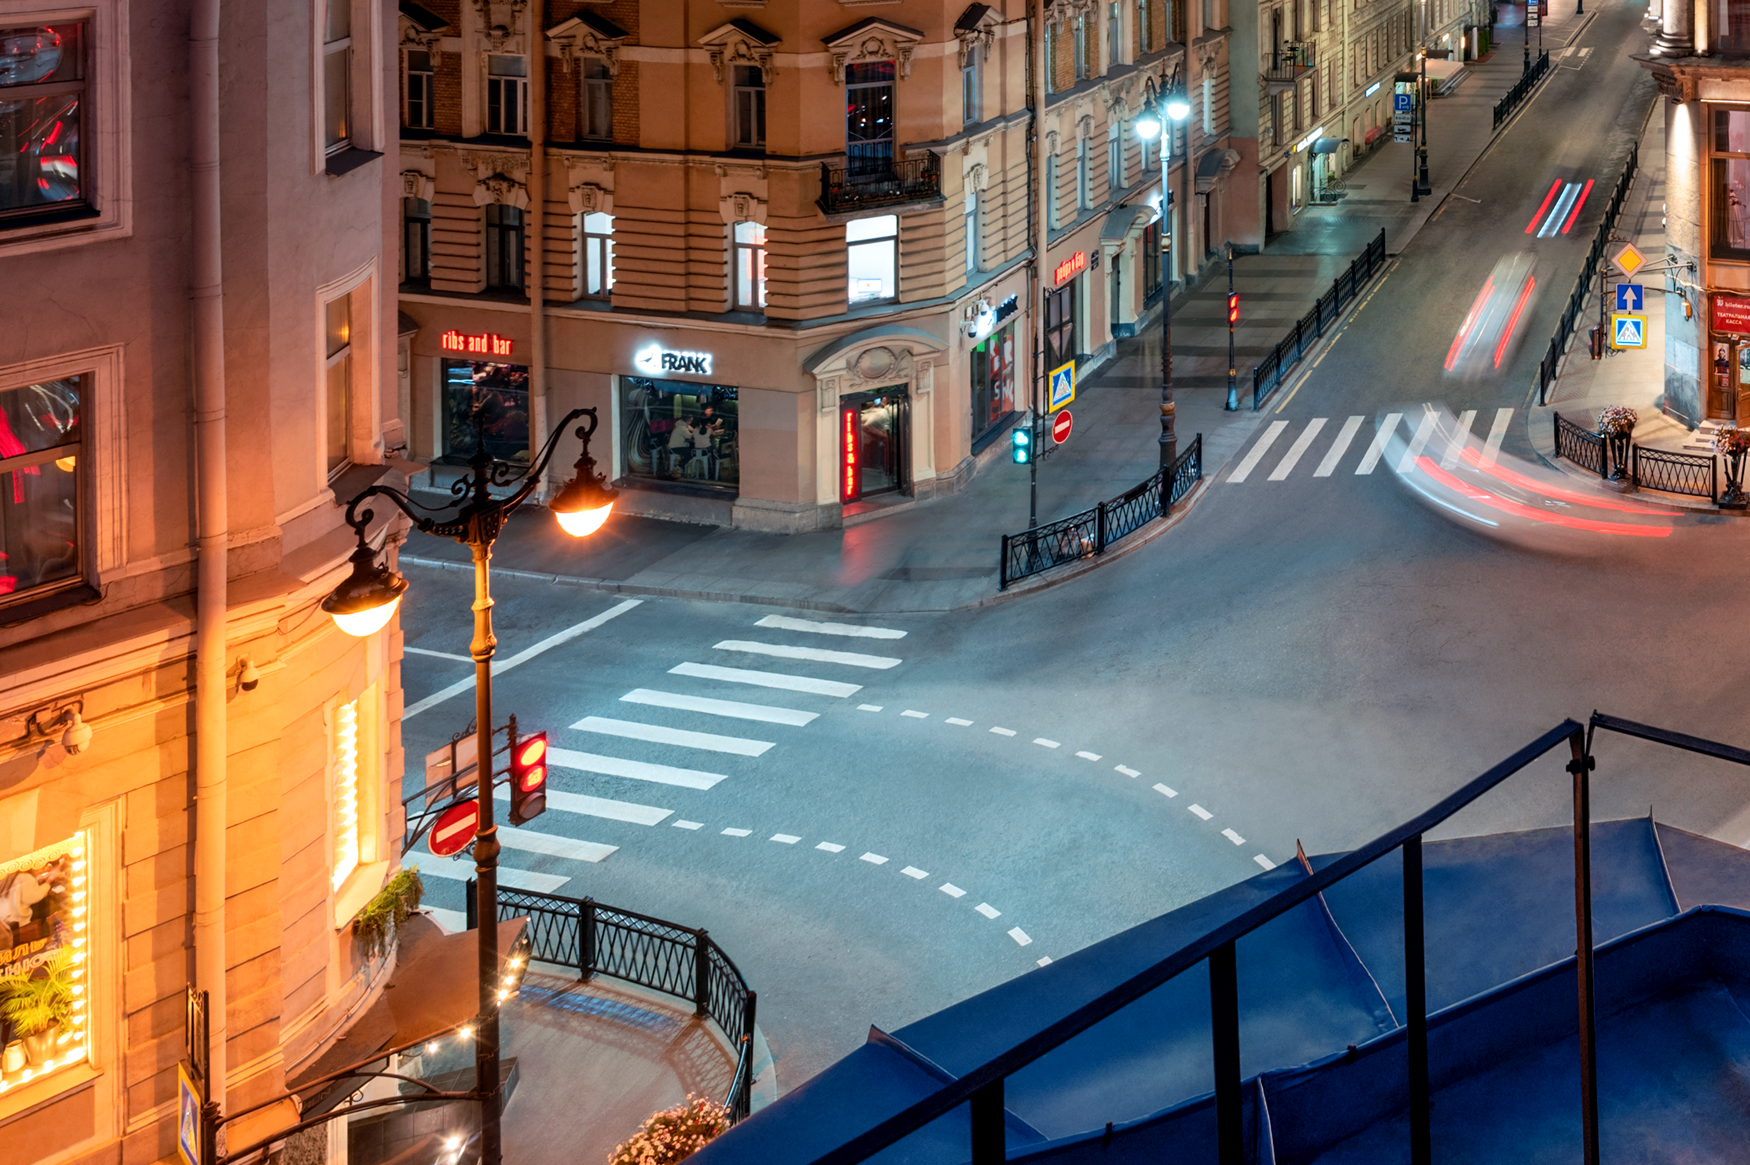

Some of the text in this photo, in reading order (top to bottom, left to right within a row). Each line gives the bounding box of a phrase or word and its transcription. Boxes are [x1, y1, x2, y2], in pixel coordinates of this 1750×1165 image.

[1398, 95, 1409, 110] P
[441, 330, 512, 356] ribs and bar
[661, 352, 708, 374] FRANK
